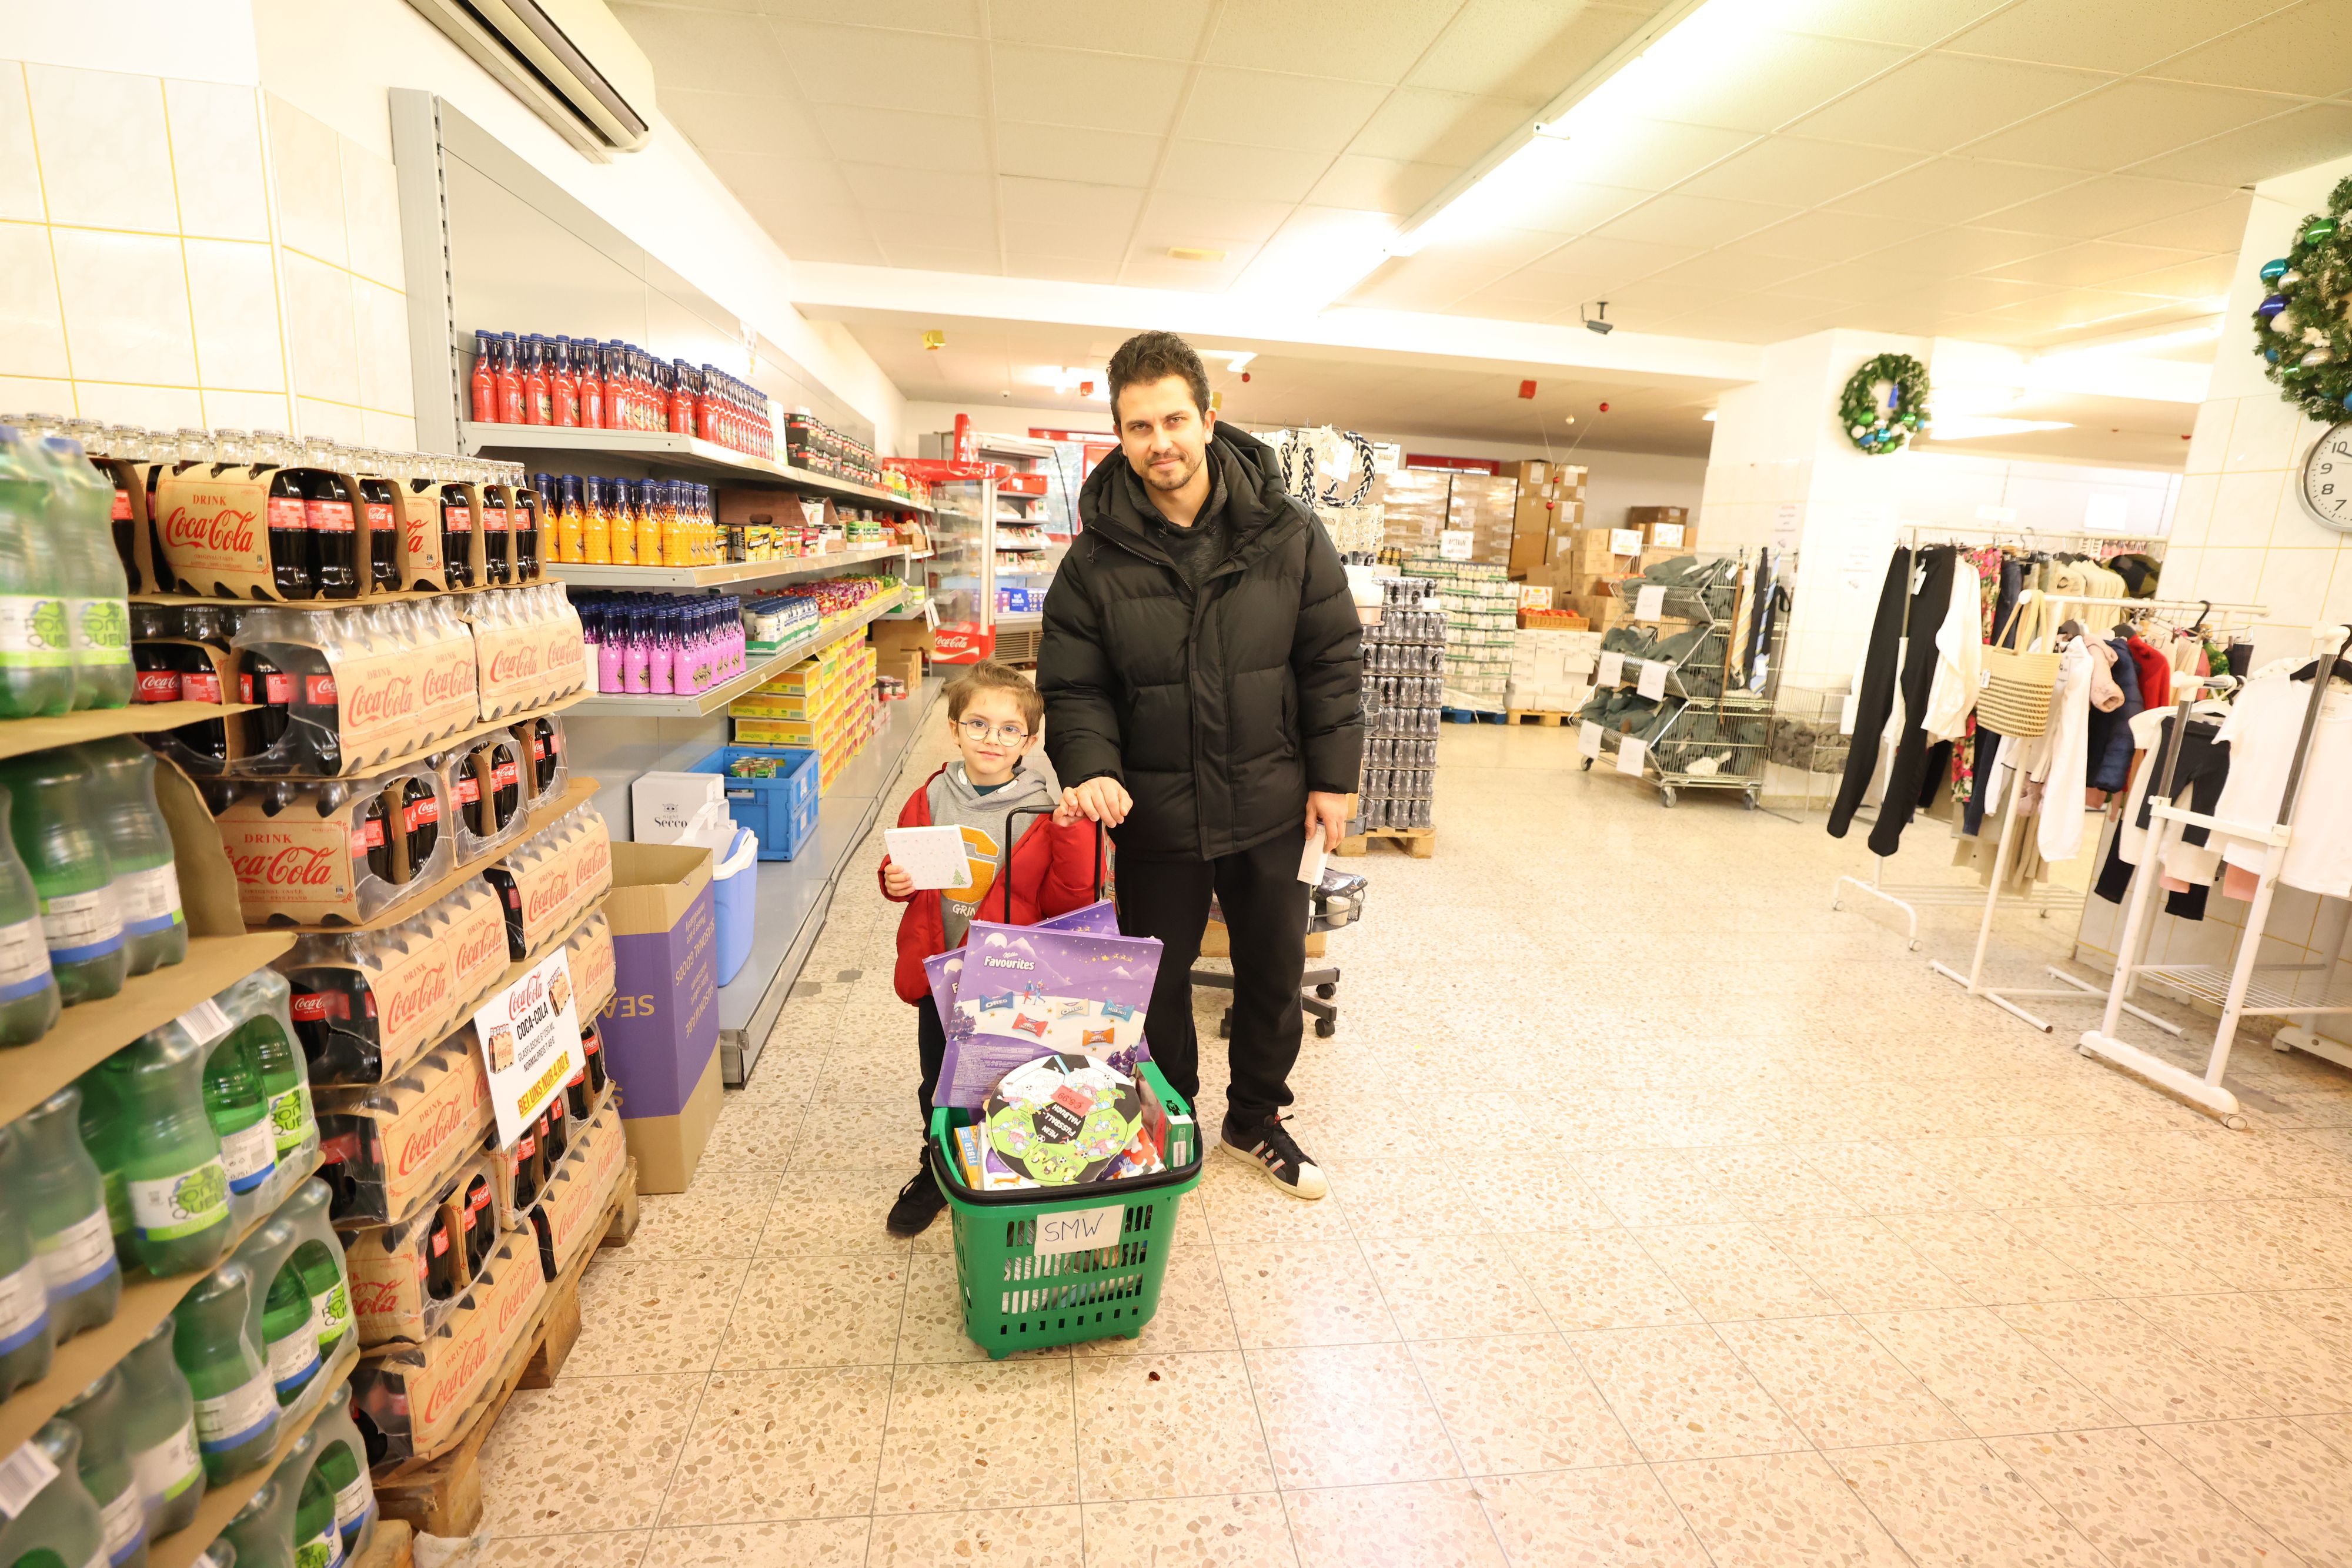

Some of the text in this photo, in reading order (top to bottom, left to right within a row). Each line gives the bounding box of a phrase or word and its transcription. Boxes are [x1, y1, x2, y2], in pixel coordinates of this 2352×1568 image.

[2331, 441, 2348, 453] 10
[2320, 463, 2333, 474] 9
[192, 494, 226, 506] DRINK
[2321, 484, 2334, 495] 8
[2334, 500, 2347, 511] 7
[166, 507, 257, 553] Coca-Cola
[507, 638, 524, 647] DRINK
[936, 636, 969, 648] Coca-Cola
[436, 650, 456, 664] DRINK
[490, 646, 538, 683] Coca-Cola
[367, 667, 392, 680] DRINK
[423, 660, 474, 706] Coca-Cola
[348, 676, 413, 727] Coca-Cola
[654, 817, 687, 828] Secco
[244, 834, 292, 843] DRINK
[584, 840, 596, 852] DRINK
[576, 842, 607, 886] Coca-Cola
[539, 870, 555, 884] DRINK
[529, 871, 569, 922] Coca-Cola
[467, 917, 487, 936] DRINK
[456, 918, 502, 979] Coca-Cola
[592, 944, 604, 958] DRINK
[403, 961, 427, 983] DRINK
[676, 951, 694, 987] GOODS
[984, 955, 1035, 971] Favourites
[388, 960, 446, 1034] Coca-Cola
[509, 971, 542, 1020] Coca-Cola
[985, 999, 1007, 1008] OREO
[517, 1002, 548, 1040] COCA-COLA
[1061, 1006, 1084, 1015] OREO
[1107, 1007, 1127, 1015] Milkinis
[518, 1035, 540, 1062] GLASFLASCHE
[524, 1045, 546, 1072] NORMALPREIS
[517, 1051, 569, 1115] BEI UNS NUR 4.00 €
[419, 1098, 442, 1123] DRINK
[1058, 1093, 1084, 1109] €5,99
[1043, 1112, 1076, 1137] FUSSBALL-
[1052, 1104, 1081, 1126] MALBUCH
[399, 1091, 462, 1176] Coca-Cola
[1041, 1125, 1059, 1139] MEIN
[965, 1142, 978, 1164] FIBER
[567, 1185, 582, 1205] DRINK
[558, 1179, 593, 1245] Coca-Cola
[1045, 1213, 1104, 1242] SMW
[499, 1256, 539, 1333] Coca-Cola
[445, 1340, 469, 1368] DRINK
[425, 1326, 487, 1423] Coca-Cola
